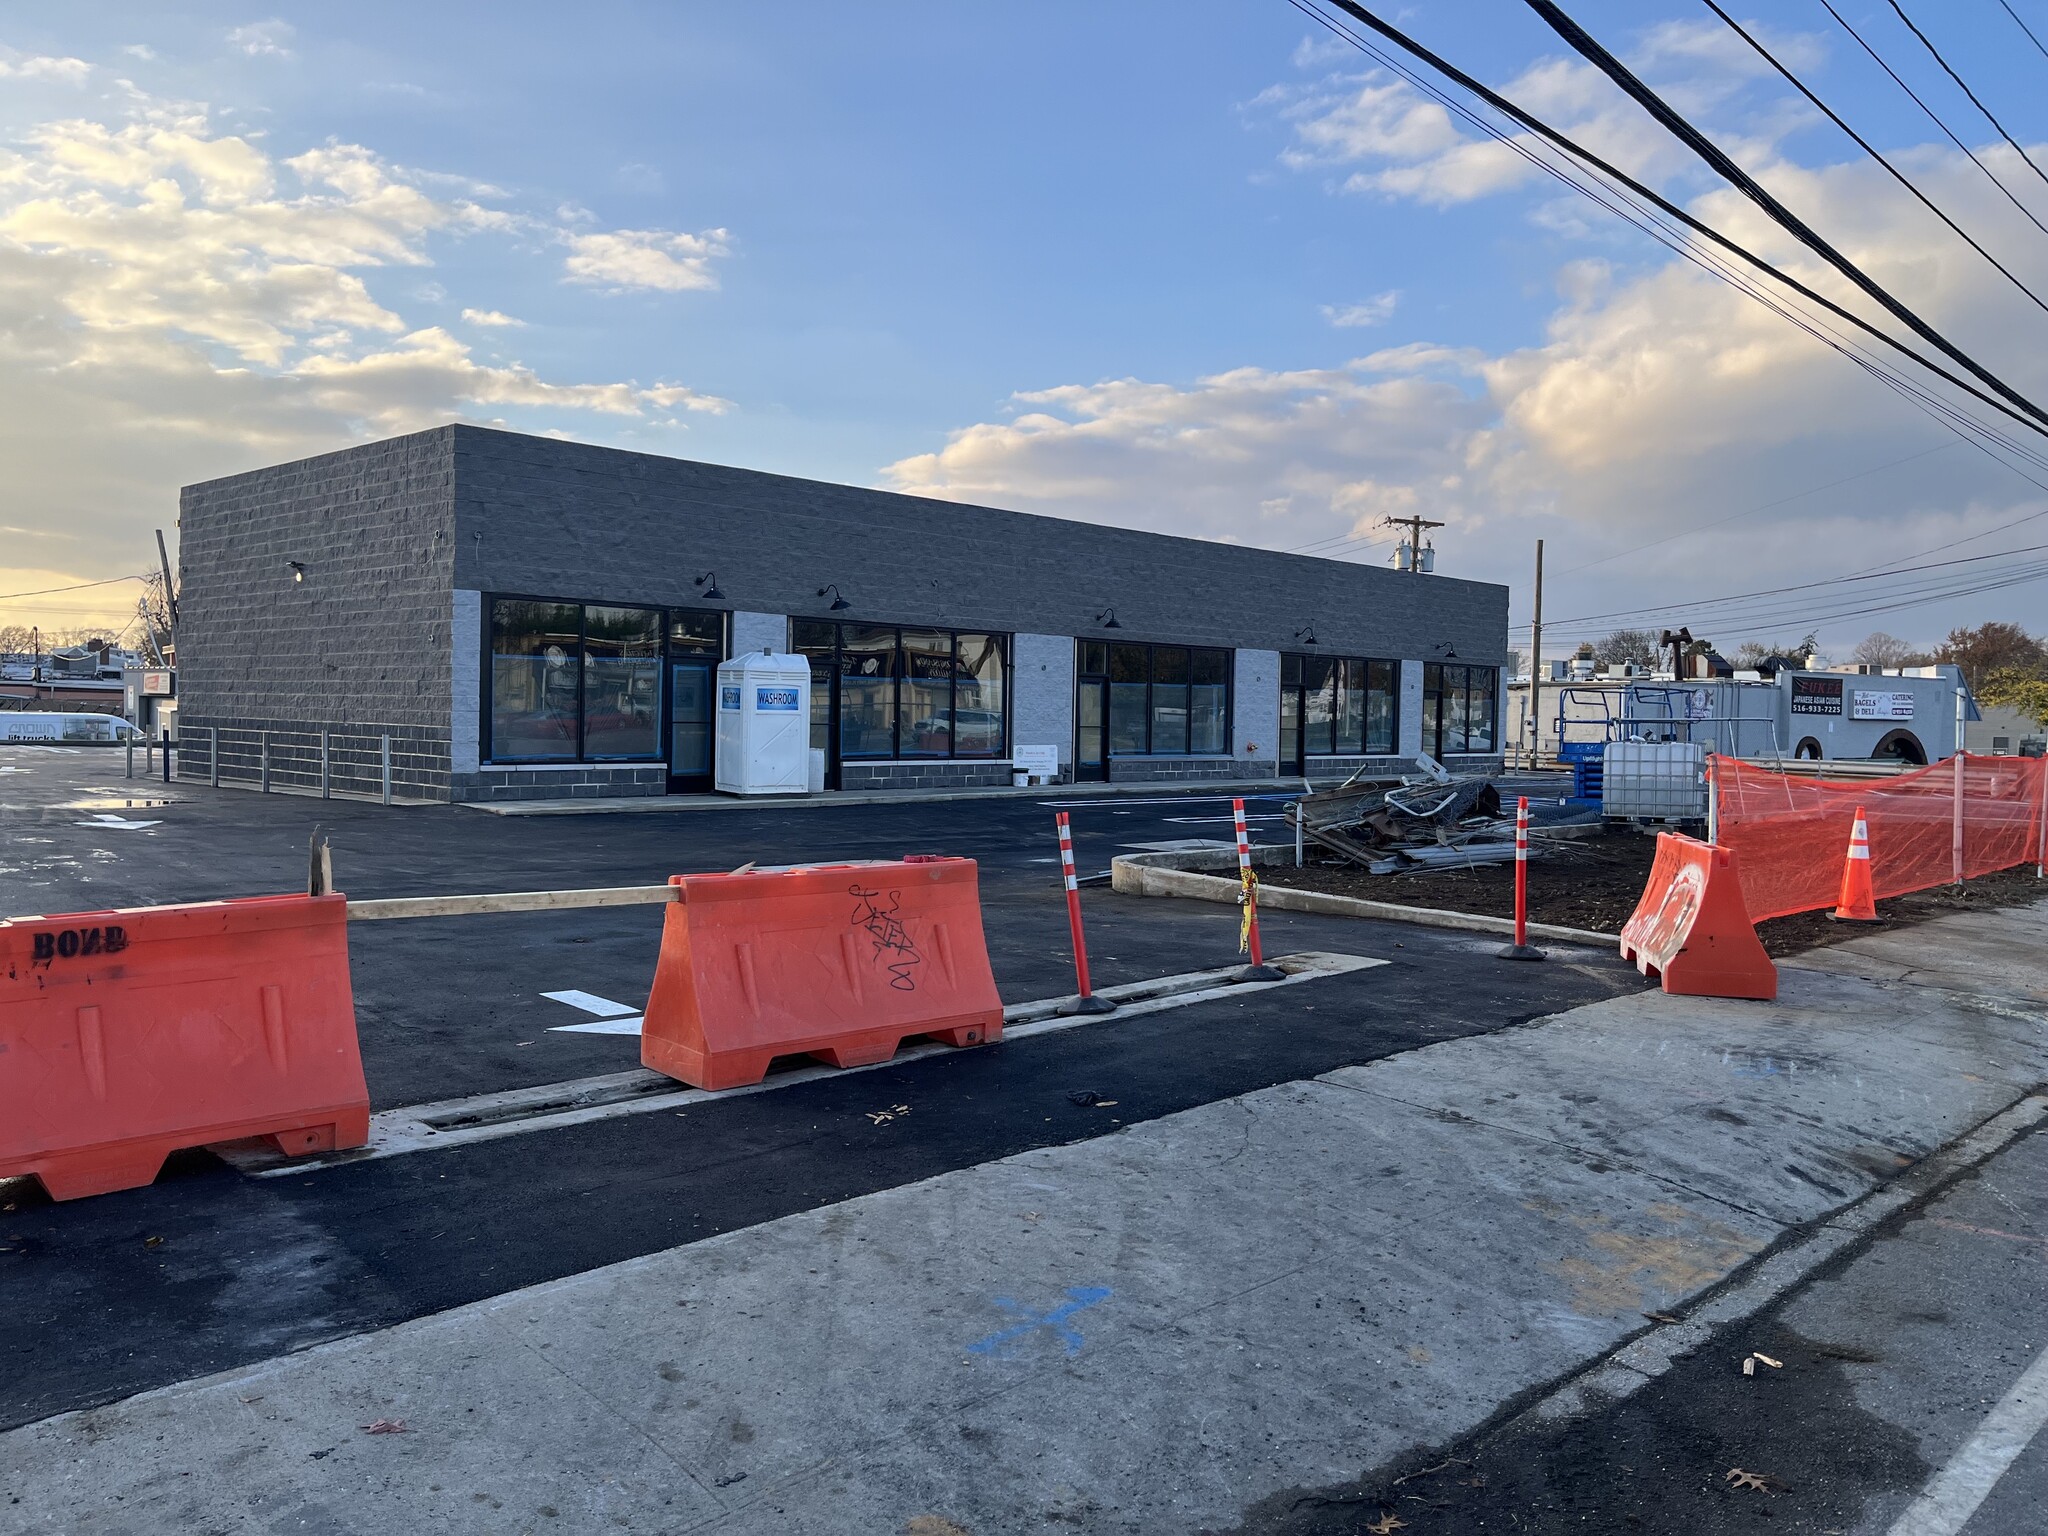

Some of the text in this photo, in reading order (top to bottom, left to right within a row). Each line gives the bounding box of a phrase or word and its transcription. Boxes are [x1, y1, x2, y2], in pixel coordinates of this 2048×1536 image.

[758, 692, 798, 705] WASHROOM
[1793, 695, 1813, 704] JAPANESE
[1891, 693, 1914, 701] CATERING
[1854, 699, 1877, 707] BAGELS
[1792, 704, 1841, 713] 516-933-7225
[1861, 708, 1875, 716] DELI
